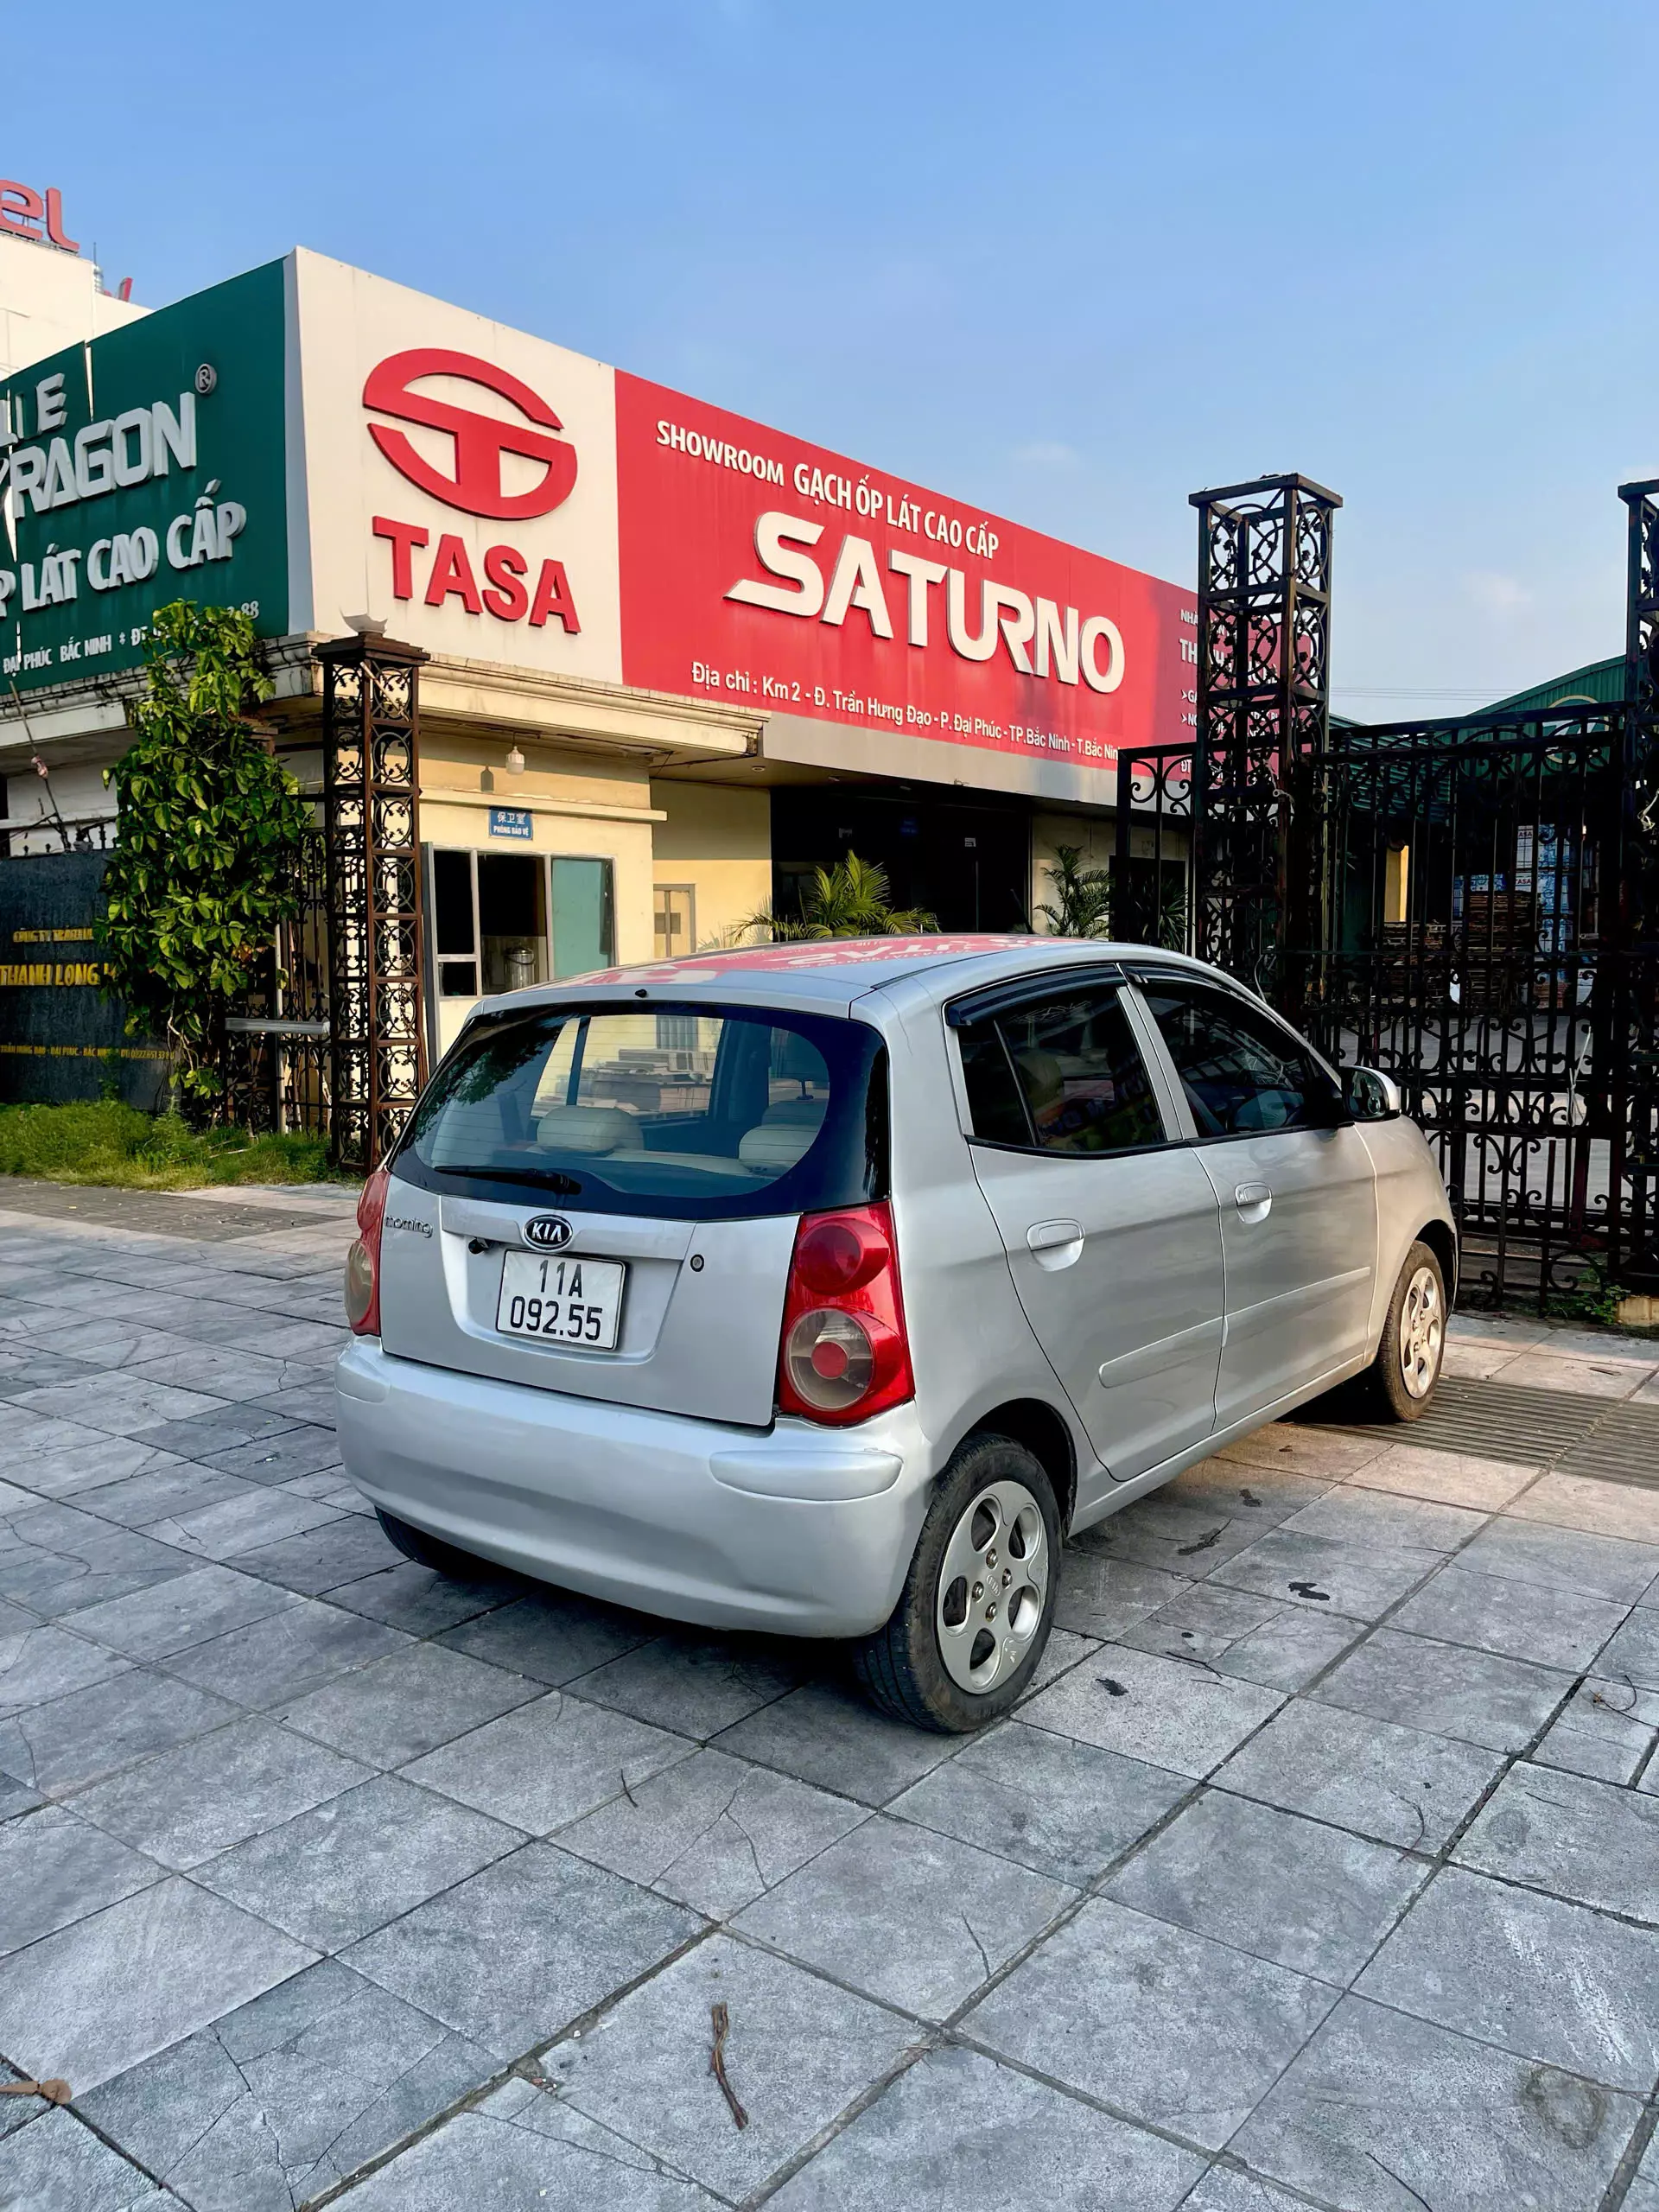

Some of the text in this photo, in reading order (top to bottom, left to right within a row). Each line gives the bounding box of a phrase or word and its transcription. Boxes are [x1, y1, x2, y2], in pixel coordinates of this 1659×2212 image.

[0, 391, 197, 518] RAGON
[656, 420, 1000, 560] SHOWROOM GẠCH ỐP LÁT CAO CẤP
[21, 543, 82, 612] LÁT
[87, 526, 159, 591] CAO
[166, 479, 247, 569] CẤP
[372, 515, 582, 635] TASA
[723, 511, 1125, 694] SATURNO
[24, 647, 53, 671] PHÚC
[60, 637, 81, 663] BẮC
[85, 634, 112, 657] NINH
[692, 661, 720, 690] Địa
[762, 676, 789, 701] Km
[814, 687, 830, 708] Đ.
[833, 690, 864, 715] Trần
[868, 697, 904, 726] Hưng
[953, 715, 972, 738] Đại
[1104, 745, 1121, 760] Nin
[498, 811, 526, 824] 保卫室
[55, 963, 100, 986] LONG
[385, 1215, 434, 1239] morning
[531, 1220, 563, 1243] KIA
[539, 1259, 583, 1298] 11A
[510, 1295, 603, 1341] 092.55
